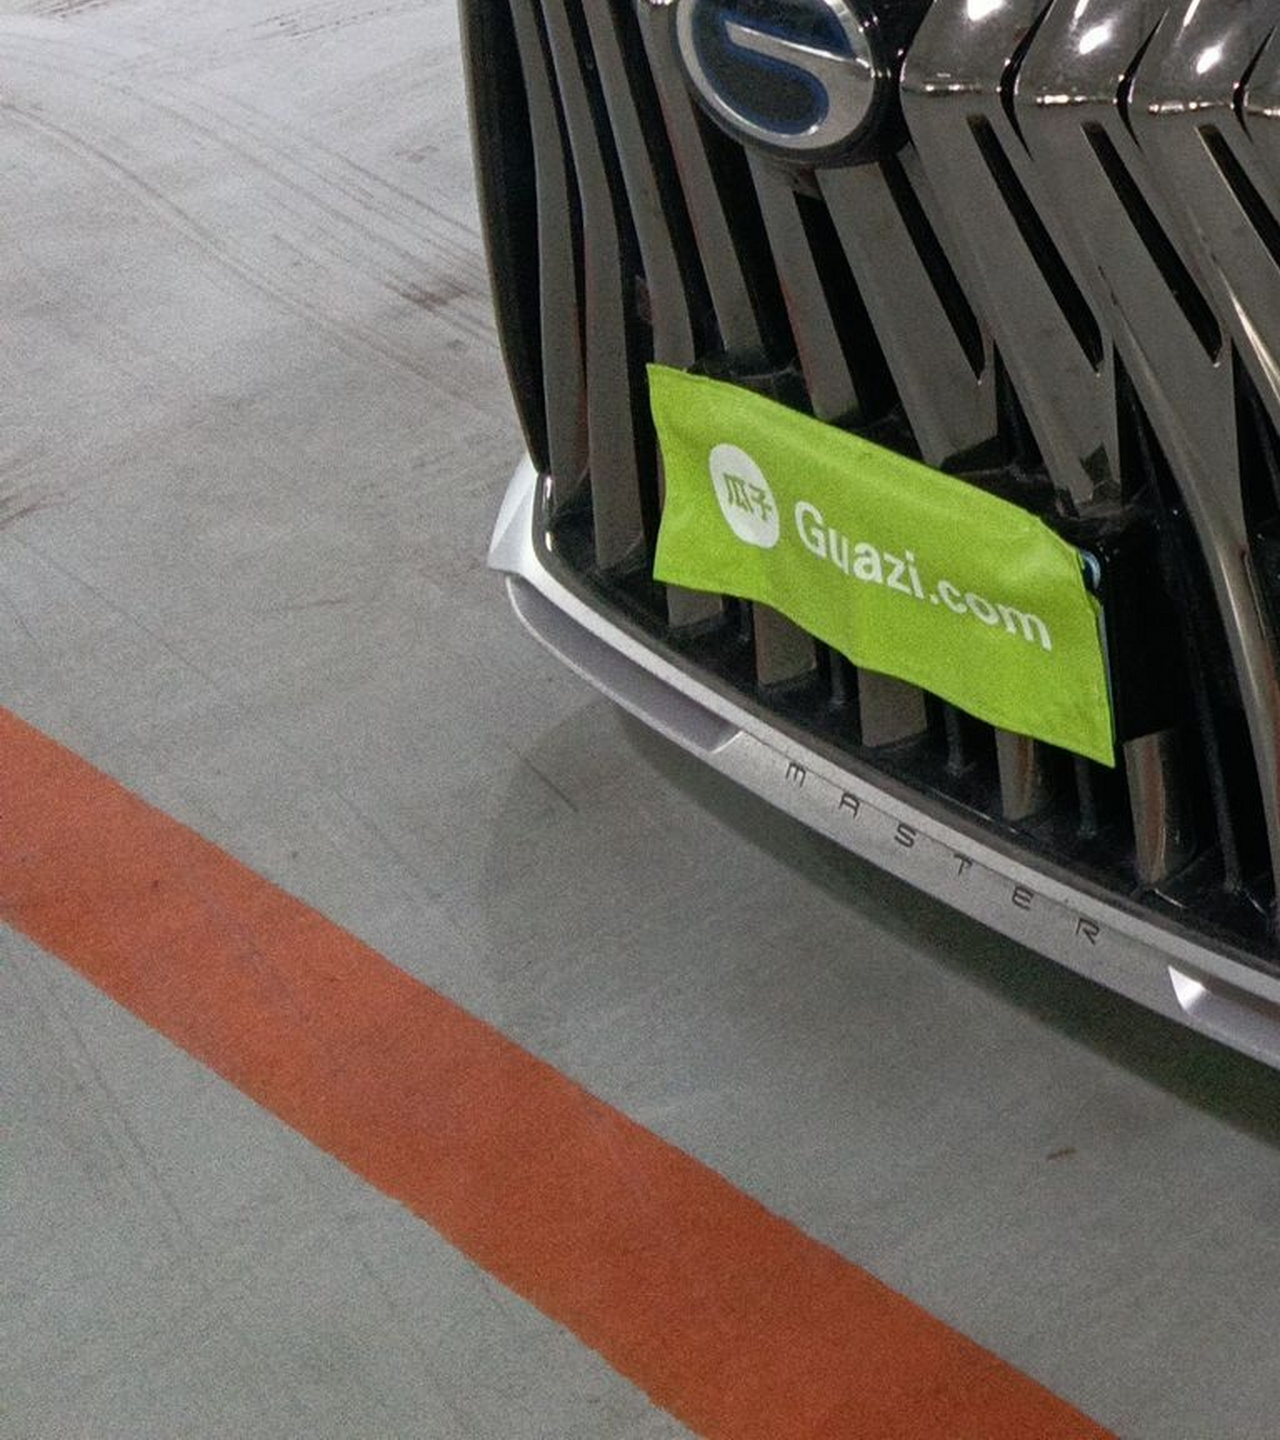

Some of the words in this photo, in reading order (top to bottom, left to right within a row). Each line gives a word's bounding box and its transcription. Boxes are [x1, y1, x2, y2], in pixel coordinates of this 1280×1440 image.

[724, 472, 773, 522] 瓜子
[795, 501, 1053, 651] Guazi.com
[785, 761, 1101, 944] MASTER
